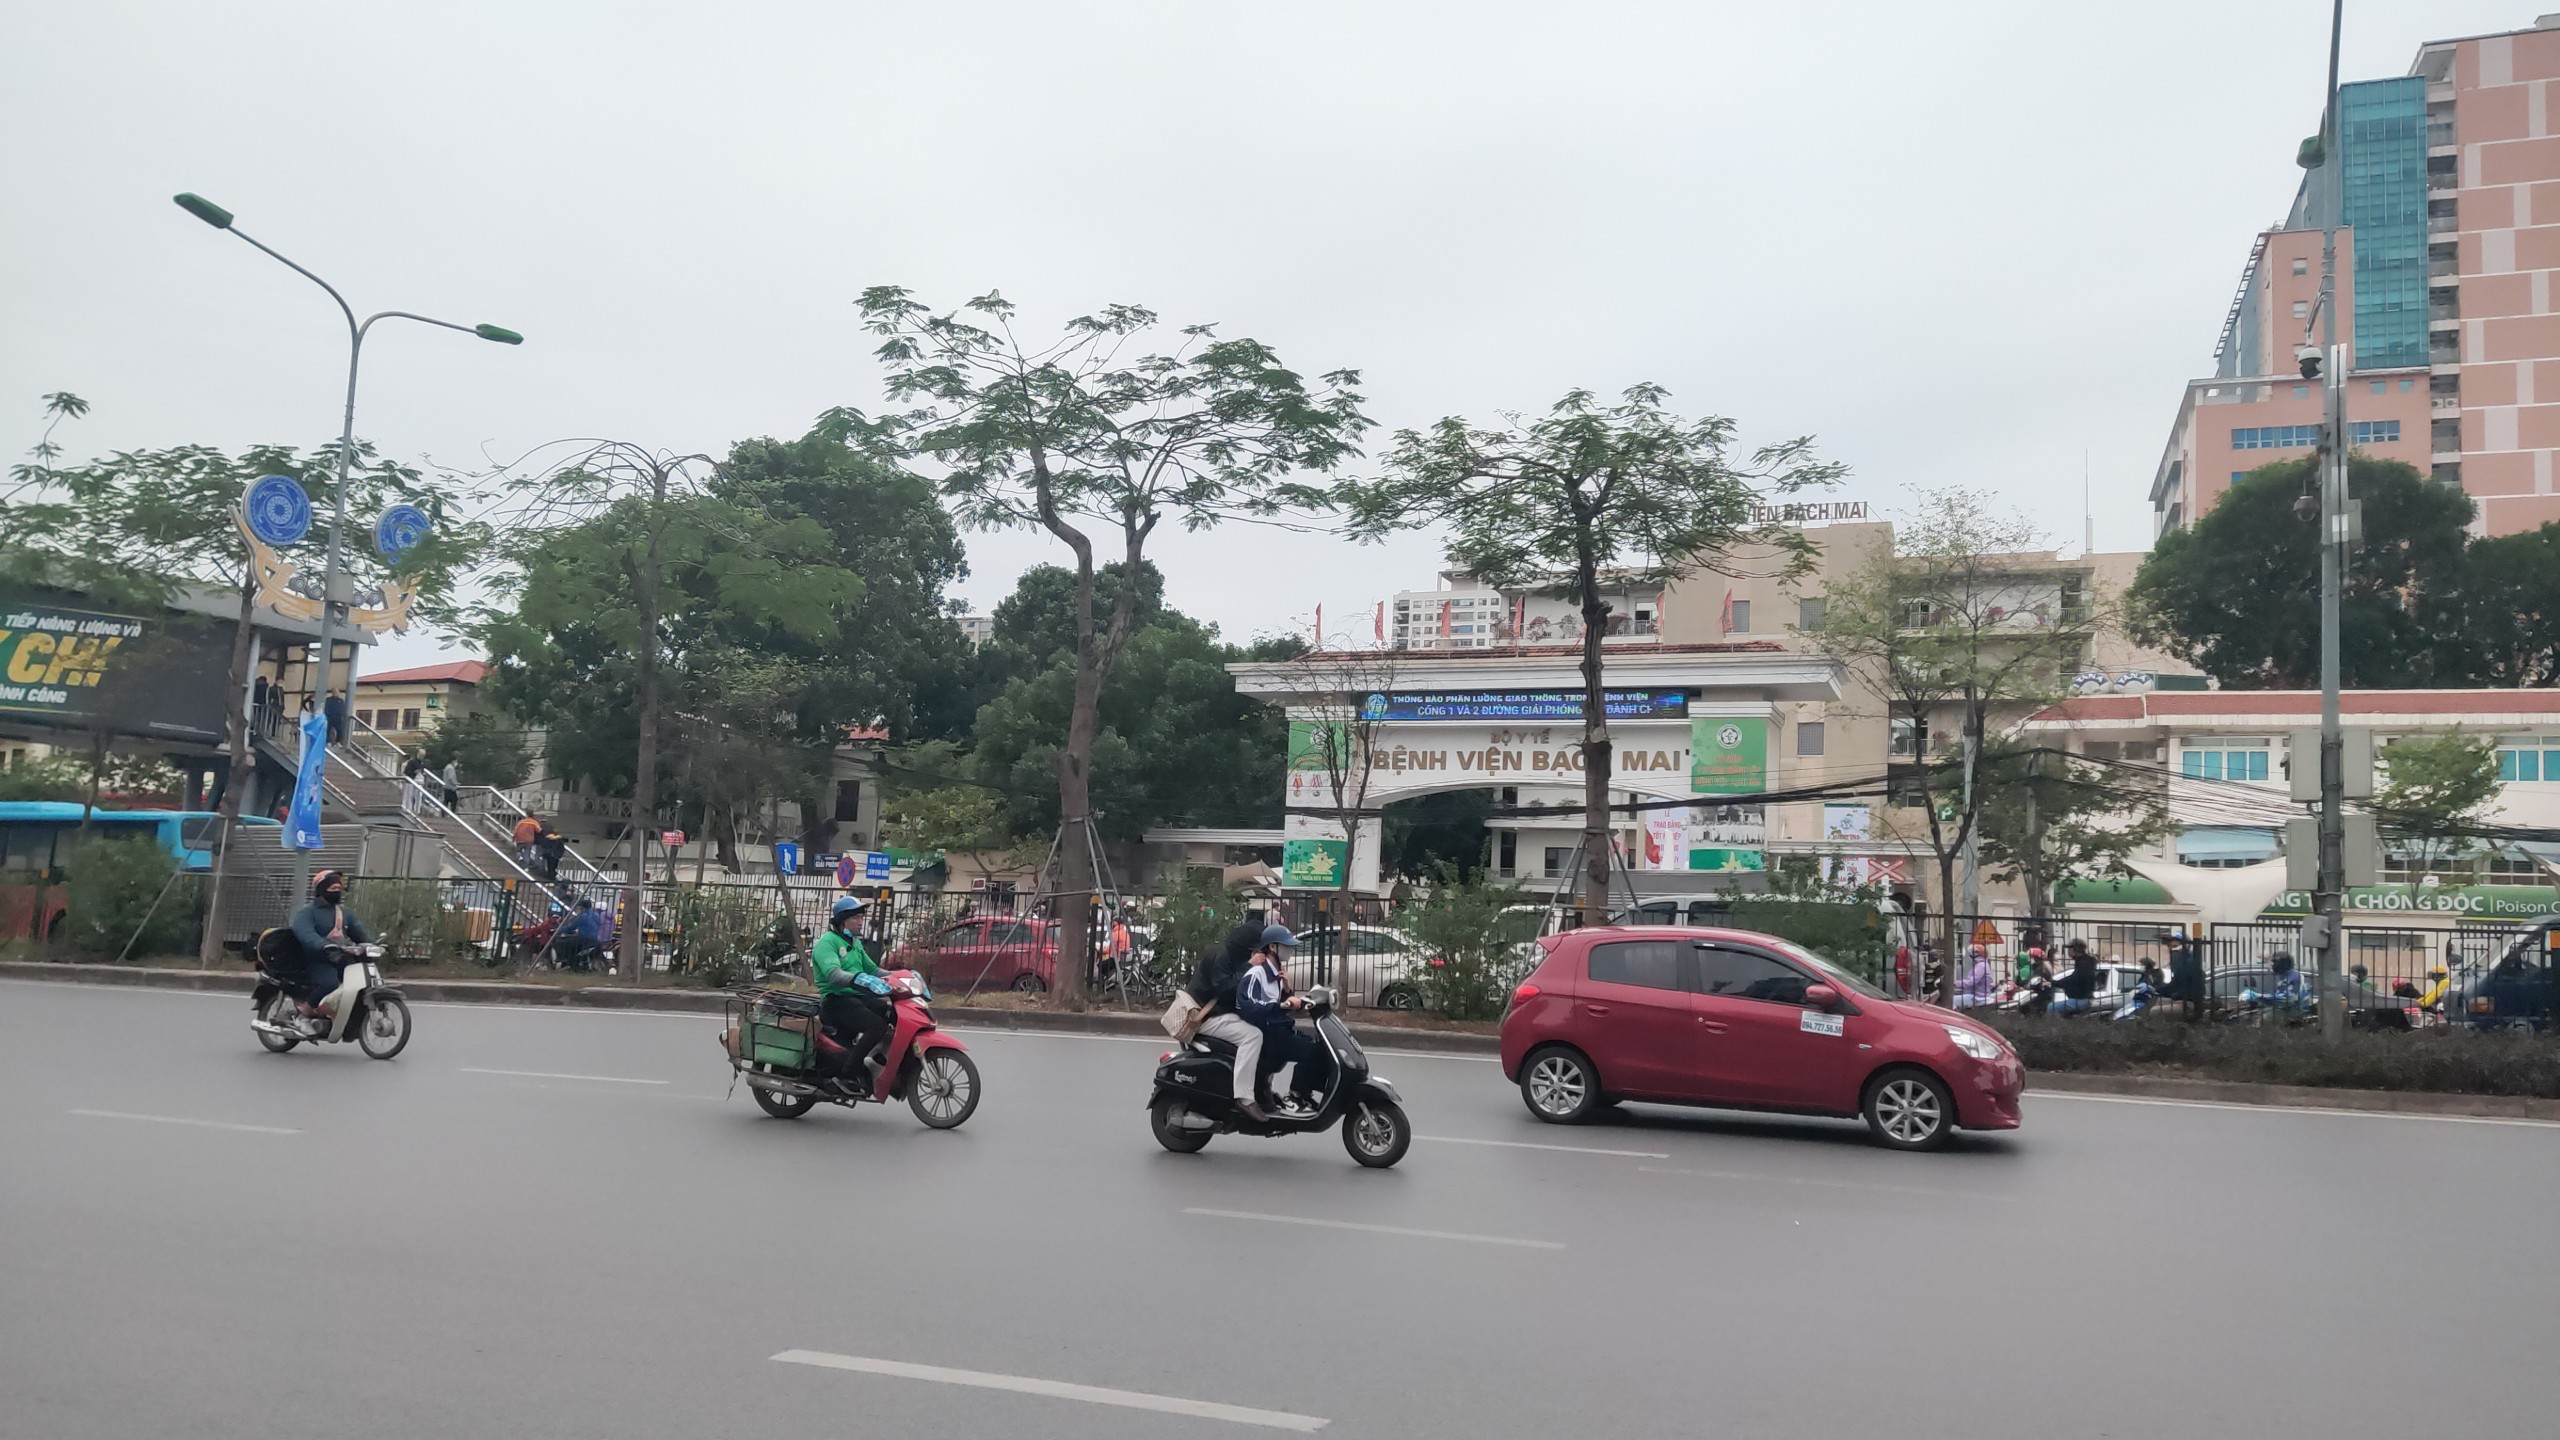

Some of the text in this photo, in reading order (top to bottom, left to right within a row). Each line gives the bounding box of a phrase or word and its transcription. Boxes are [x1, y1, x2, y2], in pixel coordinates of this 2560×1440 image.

[1753, 502, 1779, 526] IỆN
[1834, 501, 1868, 519] MAI
[77, 620, 122, 636] LƯỢNG
[27, 686, 68, 704] CÔNG
[1504, 694, 1527, 702] GIAO
[1457, 704, 1471, 715] VÀ
[1473, 705, 1479, 715] 2
[1545, 703, 1583, 714] PHÓNG
[1518, 732, 1526, 744] Y
[1532, 728, 1551, 744] TẾ
[1373, 745, 1681, 777] BỆNH VIỆN BẠC MAI
[2355, 889, 2433, 911] CHỐNG
[2496, 898, 2547, 914] Poison
